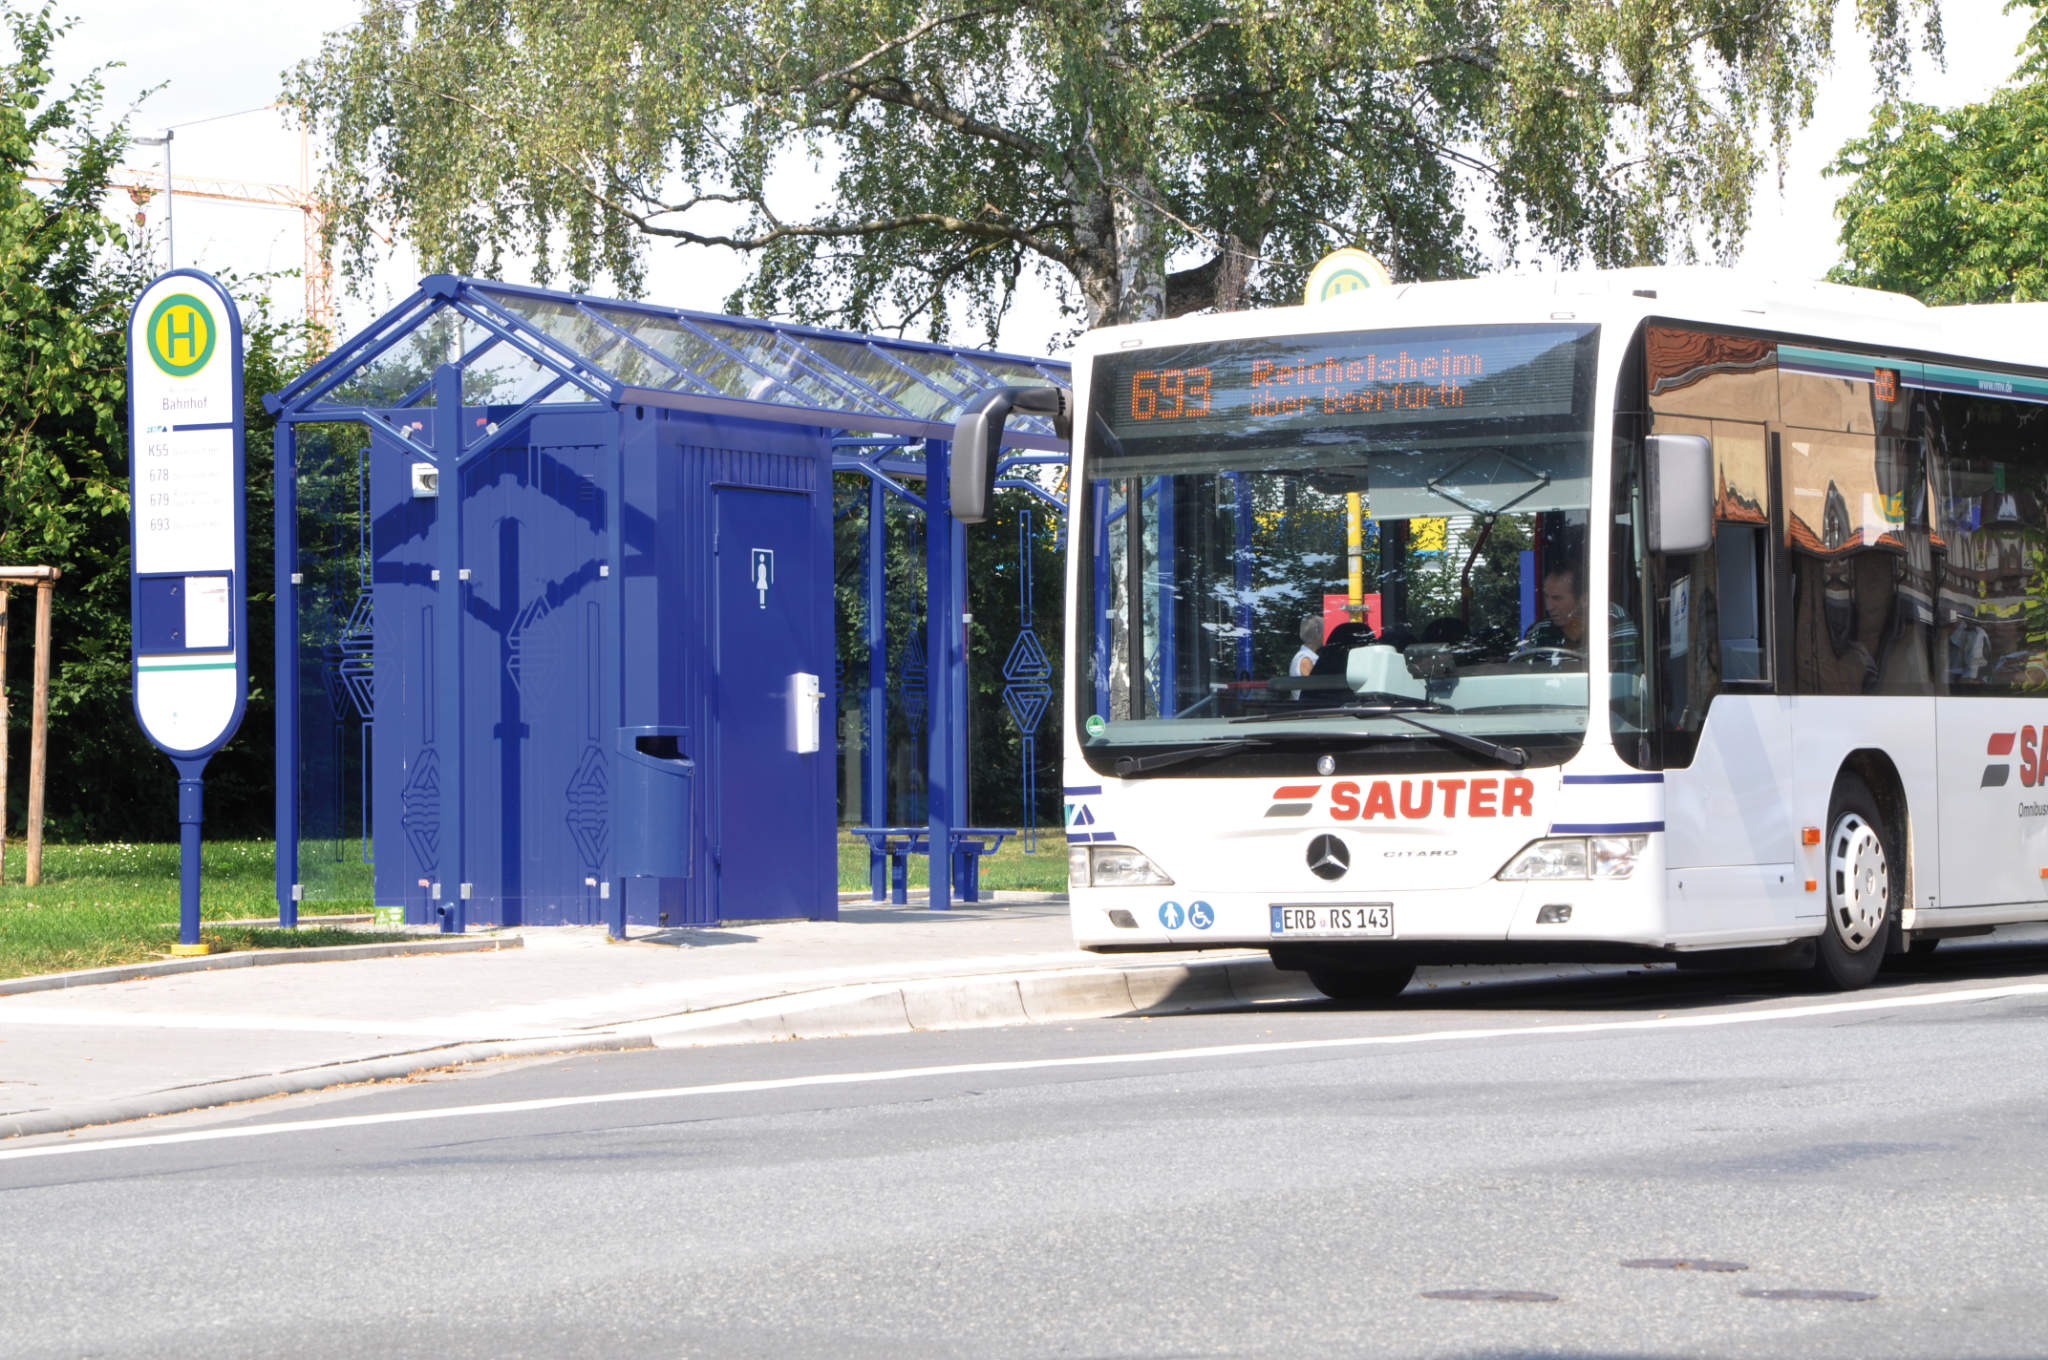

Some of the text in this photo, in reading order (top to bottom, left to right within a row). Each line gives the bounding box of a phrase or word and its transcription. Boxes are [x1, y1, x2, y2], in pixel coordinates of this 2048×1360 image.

[167, 311, 196, 359] H
[1131, 348, 1483, 420] 693 Reichelsheim
[162, 396, 208, 411] Bahnhof
[1250, 377, 1464, 417] über Beerfurth
[148, 443, 169, 457] K55
[149, 468, 169, 481] 678
[150, 493, 170, 506] 679
[150, 517, 170, 531] 693
[1329, 777, 1534, 821] SAUTER
[1383, 849, 1458, 859] CITARO
[1283, 909, 1317, 930] ERB
[1330, 909, 1353, 928] RS
[1356, 908, 1390, 928] 143
